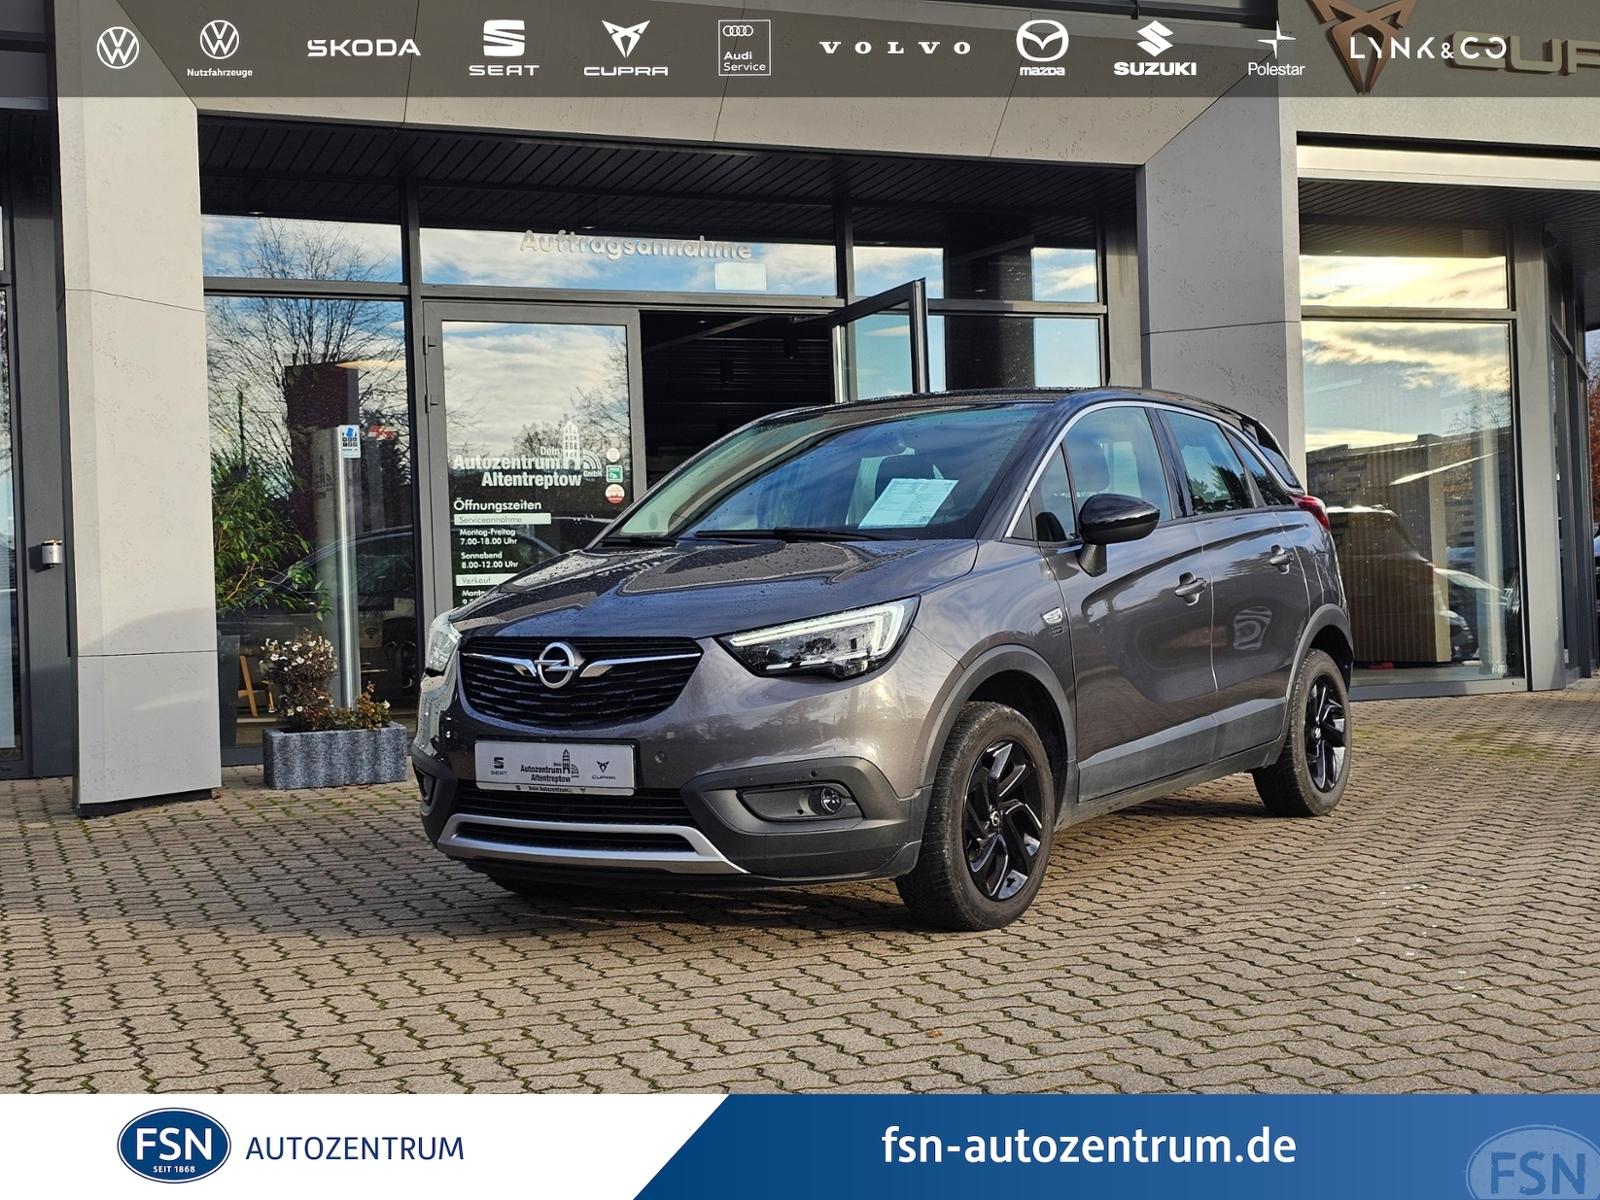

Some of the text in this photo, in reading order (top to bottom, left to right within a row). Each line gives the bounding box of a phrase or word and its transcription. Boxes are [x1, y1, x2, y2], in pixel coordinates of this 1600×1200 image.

[520, 229, 752, 260] Auftragsannahme
[452, 454, 561, 470] Autozentrum
[481, 471, 582, 489] Altentreptow
[453, 497, 542, 512] Öffnungszeiten
[459, 516, 523, 524] Serviceannahme
[460, 528, 516, 537] Montag-Freitag
[460, 537, 518, 546] 7.00-18.00 Uhr
[461, 551, 503, 560] Sonnabend
[504, 560, 519, 568] Uhr
[520, 764, 562, 774] Autozentrum
